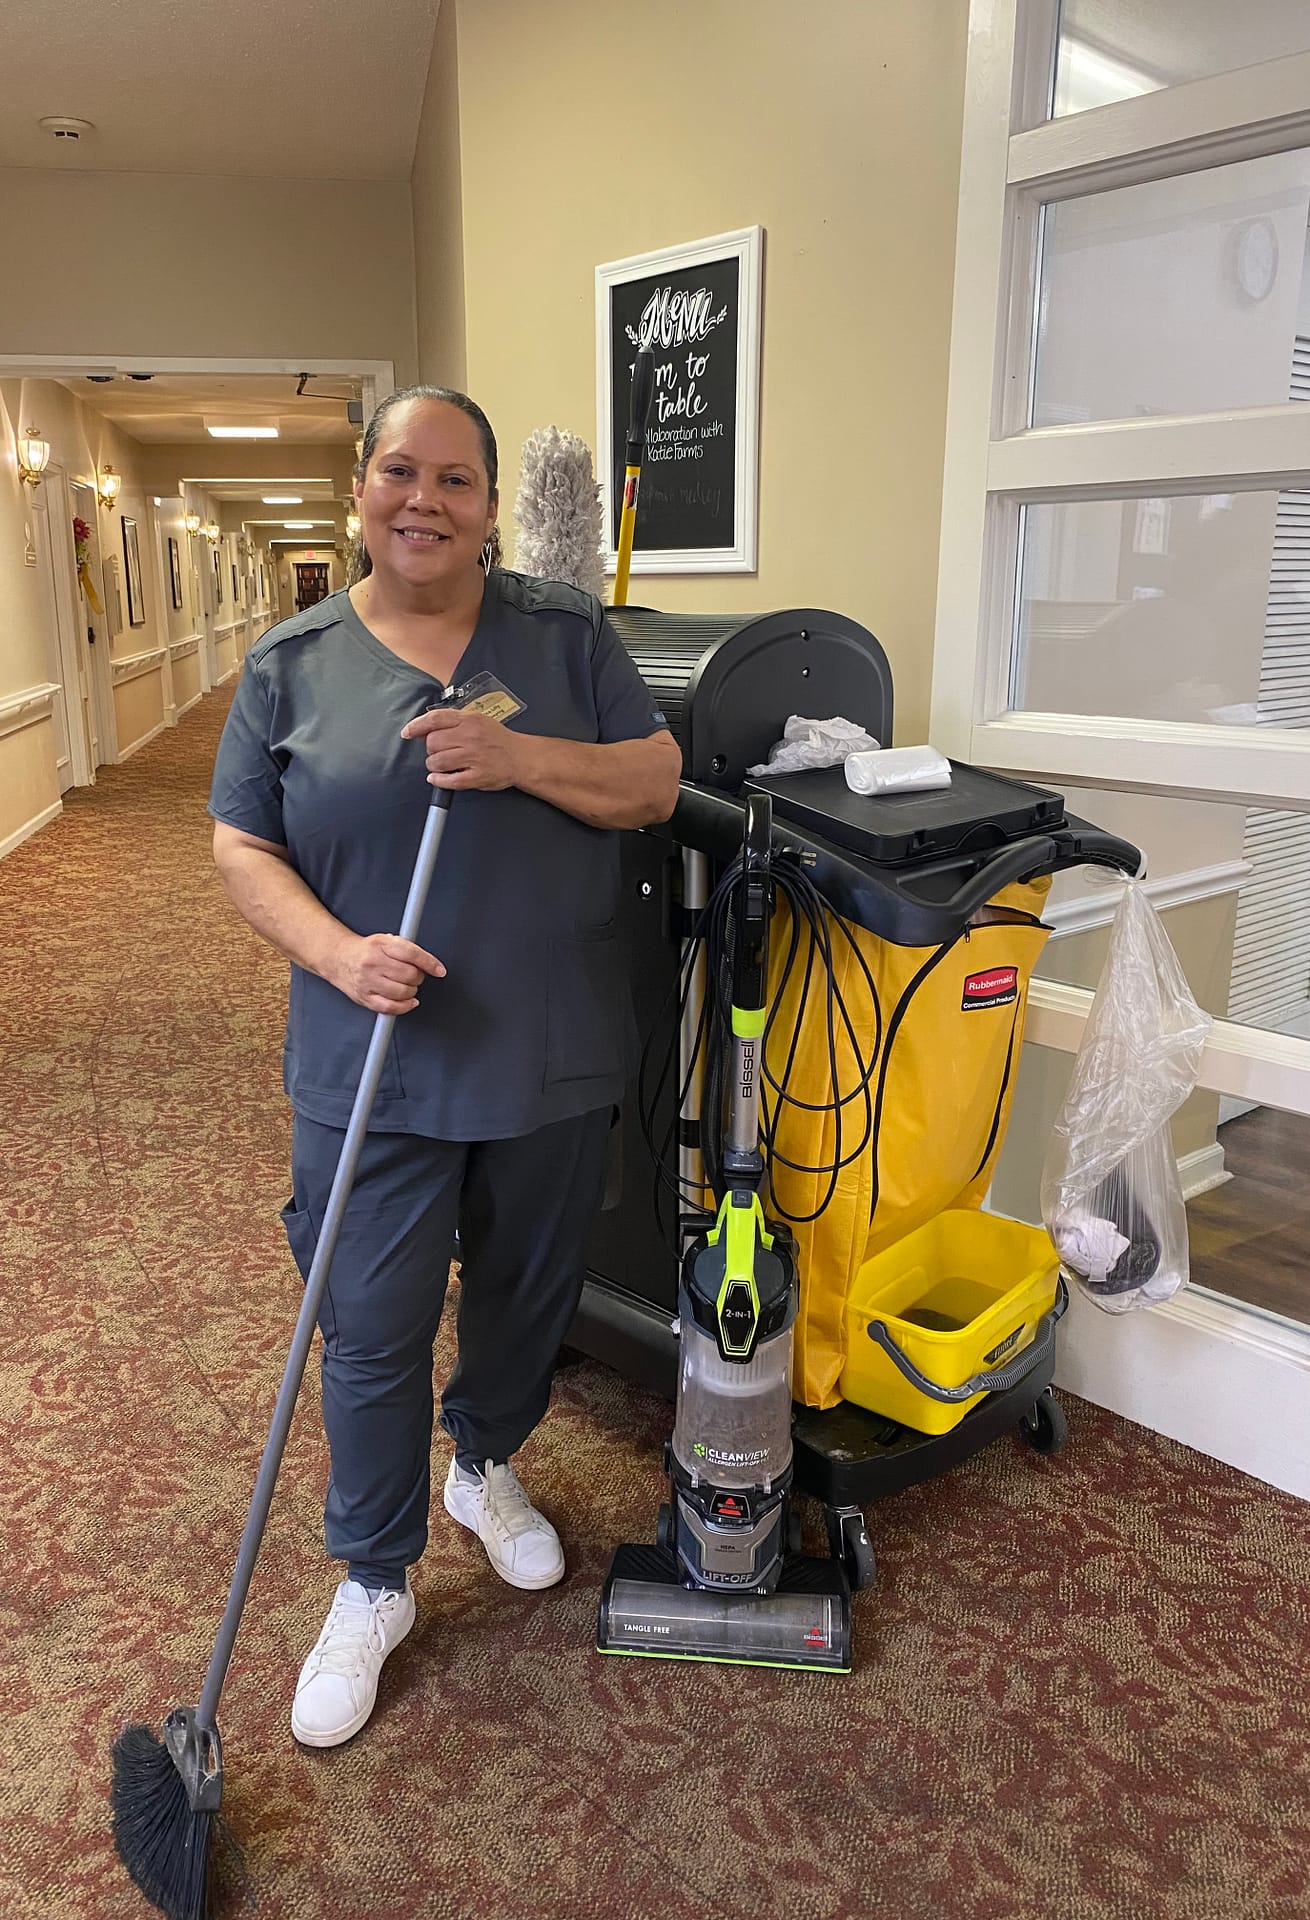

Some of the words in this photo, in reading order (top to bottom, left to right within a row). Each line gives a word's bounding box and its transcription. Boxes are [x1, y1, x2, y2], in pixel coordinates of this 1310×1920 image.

[685, 351, 711, 379] to
[655, 381, 708, 423] table
[638, 425, 698, 444] llaboration
[701, 419, 724, 438] with
[674, 442, 704, 461] Farms
[968, 974, 1013, 991] Rubbermaid
[963, 998, 996, 1009] Commercial
[725, 1308, 751, 1319] 2-IN-1
[708, 1447, 770, 1462] CLEANVIEW
[708, 1457, 736, 1467] ALLERGEN
[703, 1570, 752, 1584] LIFT-OFF
[623, 1623, 651, 1633] TANGLE
[653, 1626, 670, 1634] FREE
